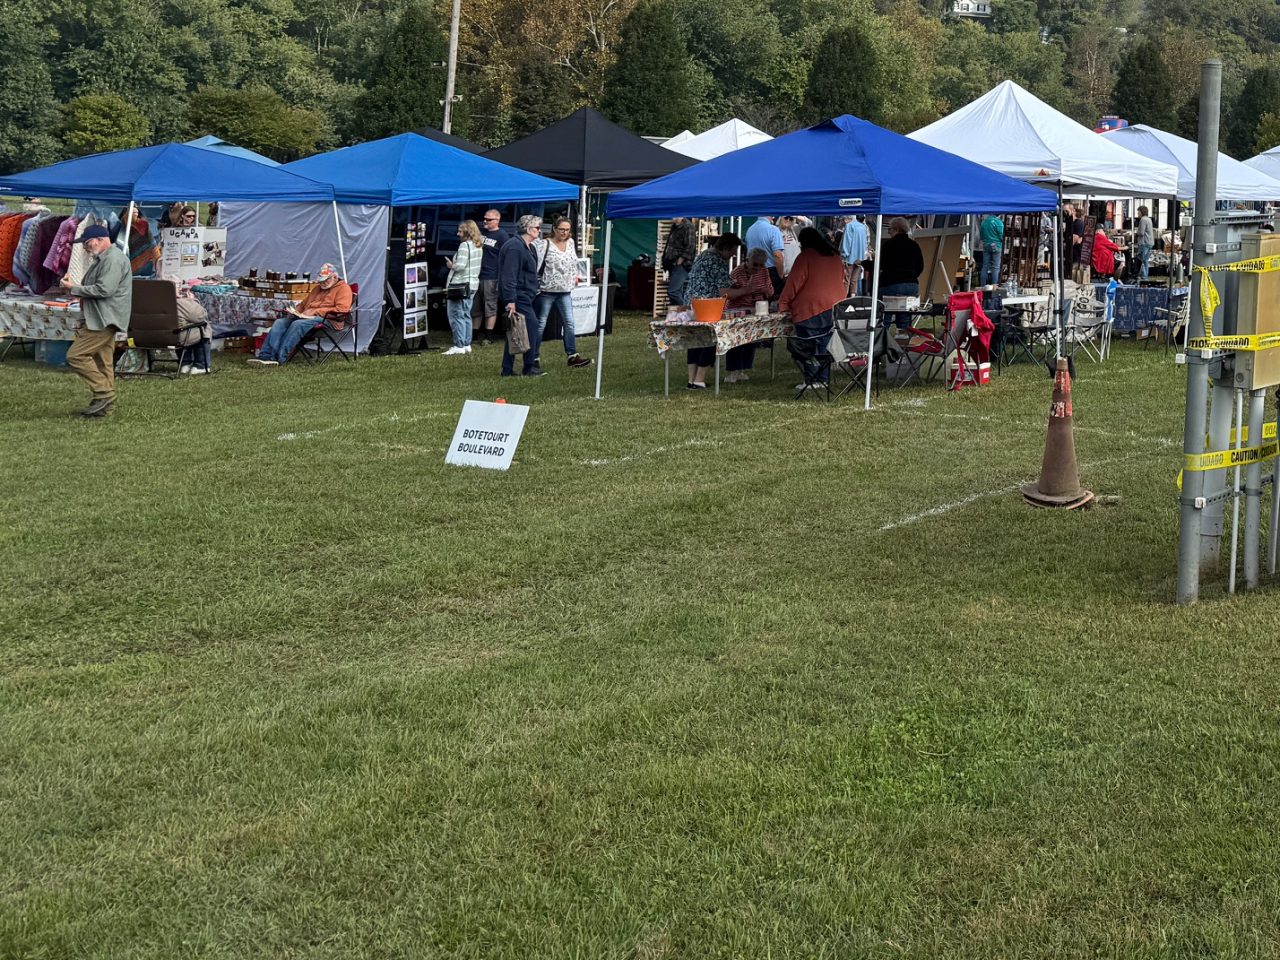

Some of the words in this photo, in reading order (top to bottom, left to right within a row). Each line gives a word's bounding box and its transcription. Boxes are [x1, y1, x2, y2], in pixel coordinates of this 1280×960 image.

[169, 228, 199, 239] UGANDA
[462, 429, 510, 442] BOTETOURT
[457, 443, 505, 456] BOULEVARD
[1200, 453, 1224, 467] UIDADO
[1230, 449, 1257, 463] CAUTION
